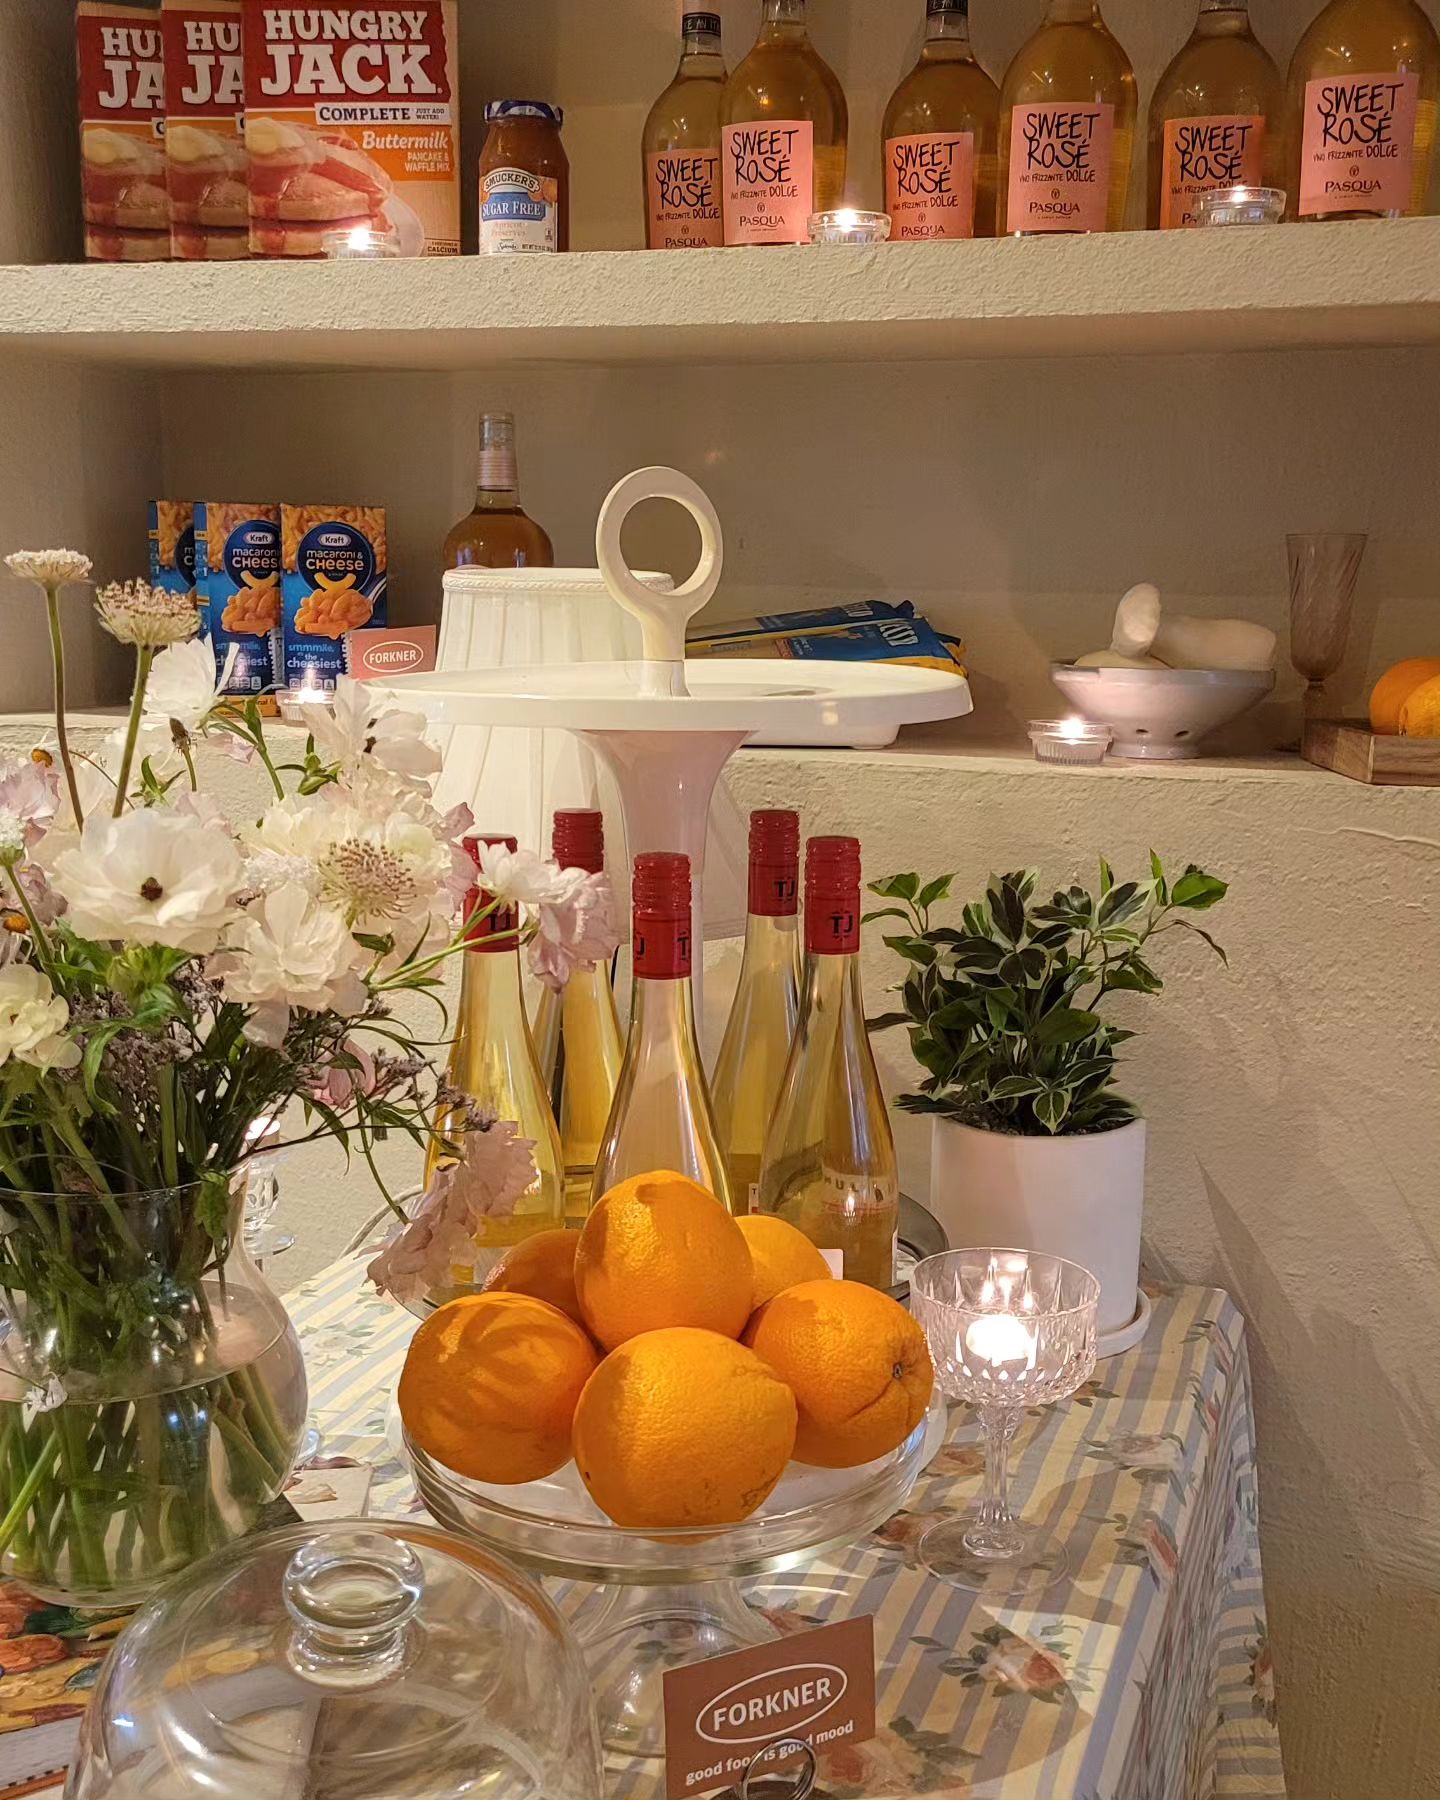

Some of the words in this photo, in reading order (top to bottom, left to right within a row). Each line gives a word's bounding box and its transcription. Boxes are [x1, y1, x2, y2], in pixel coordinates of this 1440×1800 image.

[262, 10, 428, 40] HUNGRY
[183, 21, 240, 51] HU
[261, 45, 437, 95] JACK
[98, 60, 165, 109] JA
[181, 55, 244, 104] JA
[1317, 83, 1404, 115] SWEET
[319, 106, 411, 121] COMPLETE
[1023, 112, 1100, 139] SWEET
[1323, 111, 1391, 147] ROSÉ
[362, 131, 449, 150] Buttermilk
[731, 130, 799, 158] SWEET
[1175, 125, 1253, 153] SWEET
[407, 152, 442, 161] PANCAKE
[893, 141, 960, 169] SWEET
[1027, 139, 1090, 170] ROSÉ
[1366, 144, 1399, 158] DOLCE
[404, 162, 435, 172] WAFFLE
[656, 158, 718, 183] SWEET
[736, 154, 791, 185] ROSÉ
[1180, 150, 1242, 182] ROSÉ
[485, 173, 537, 190] SMUCKER'S
[897, 165, 952, 197] ROSÉ
[1066, 169, 1096, 182] DOLCE
[661, 181, 713, 209] ROSÉ
[769, 184, 799, 198] DOLCE
[1325, 180, 1382, 193] PASQUA
[482, 202, 509, 217] SUGAR
[512, 201, 541, 216] FREE
[930, 195, 958, 207] DOLCE
[1029, 202, 1081, 215] PASQUA
[692, 207, 720, 219] DOLCE
[739, 216, 785, 227] PASQUA
[901, 225, 945, 237] PASQUA
[665, 237, 708, 248] PASQUA
[250, 534, 269, 543] Kraft
[324, 536, 345, 544] Kraft
[232, 548, 279, 557] macaron
[306, 550, 356, 559] macaroni
[305, 652, 322, 661] the
[369, 650, 417, 664] FORKNER
[774, 880, 795, 898] TJ
[831, 913, 854, 934] TJ
[713, 1677, 832, 1731] FORKNER
[685, 1761, 723, 1786] good
[726, 1756, 751, 1773] foo
[763, 1748, 776, 1761] is
[816, 1722, 854, 1744] mood
